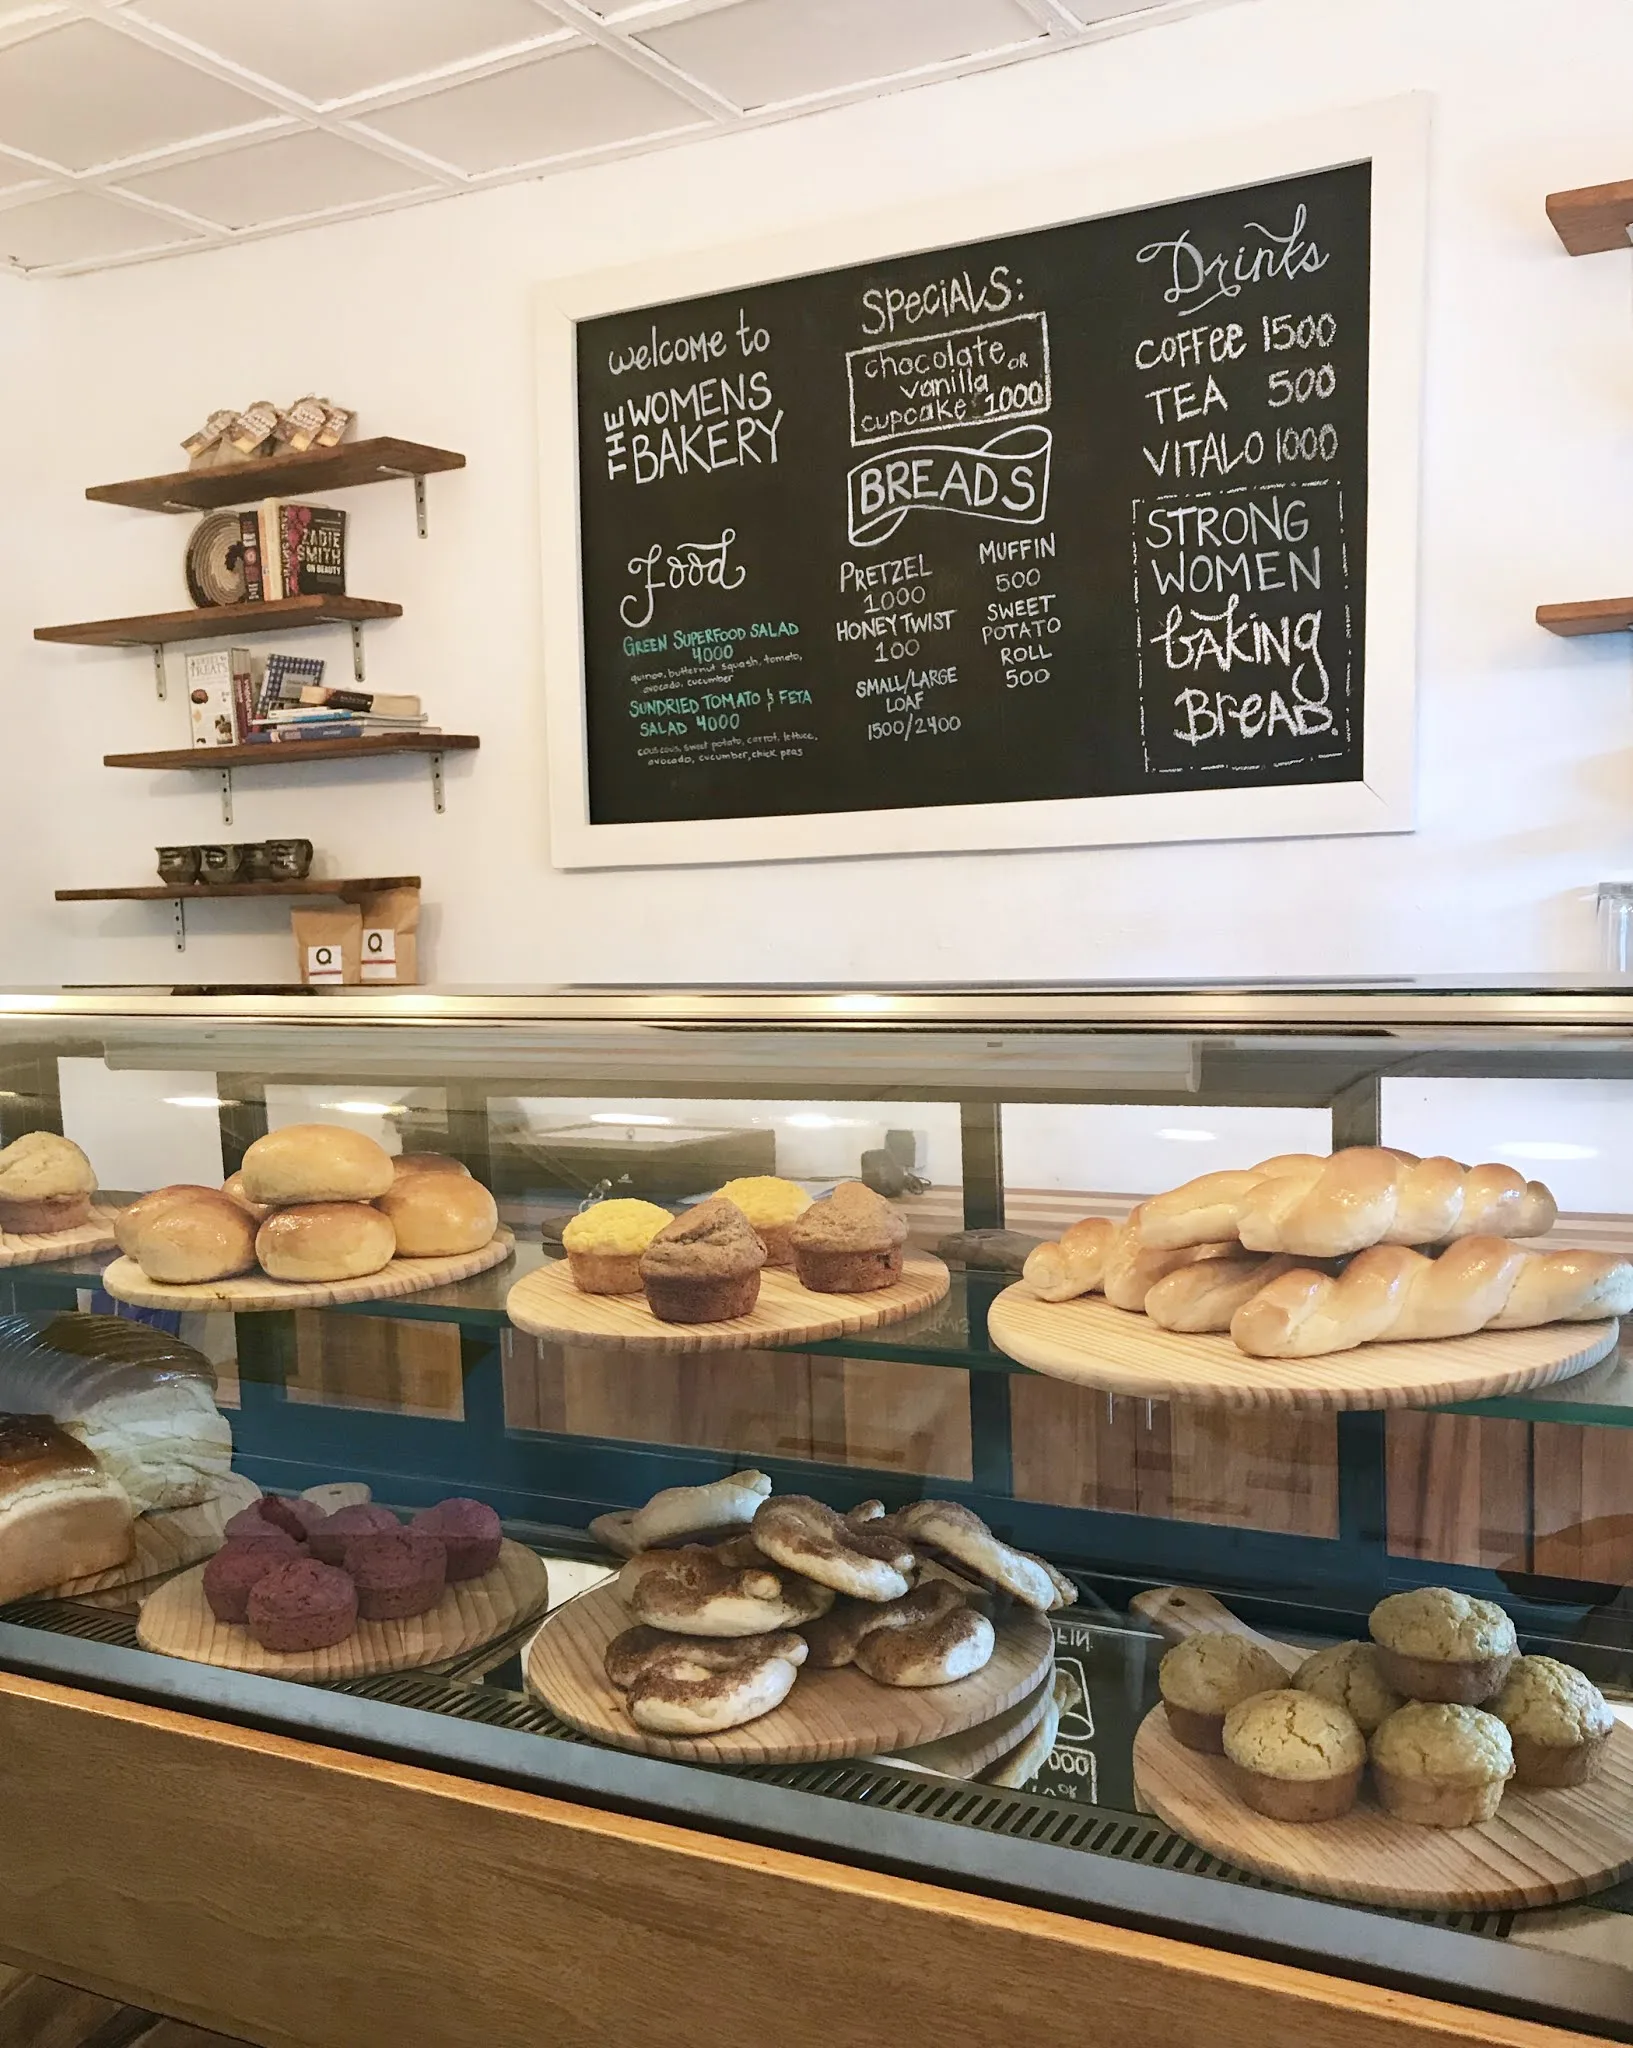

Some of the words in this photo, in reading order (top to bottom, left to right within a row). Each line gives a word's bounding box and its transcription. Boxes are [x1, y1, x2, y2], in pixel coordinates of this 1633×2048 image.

[1136, 203, 1330, 317] Drinks
[736, 308, 770, 356] to
[1261, 311, 1338, 353] 1500
[865, 335, 1006, 379] chocolate
[900, 369, 989, 399] vanilla
[1145, 374, 1229, 425] TEA
[1267, 361, 1337, 408] 500
[627, 371, 772, 427] WOMENS
[860, 398, 967, 434] cupcake
[983, 380, 1044, 417] 1000
[603, 405, 627, 480] THE
[632, 408, 784, 484] BAKERY
[1142, 430, 1265, 478] VITALO
[1275, 422, 1339, 465] 1000
[860, 459, 1036, 515] BREADS
[1146, 495, 1310, 549] STRONG
[301, 528, 341, 548] ZADIE
[978, 532, 1056, 565] MUFFIN
[296, 544, 341, 565] SMITH
[306, 563, 316, 574] ON
[316, 565, 341, 576] BEAUTY
[619, 528, 746, 628] Food
[840, 553, 933, 593] PRETZEL
[995, 568, 1042, 593] 500
[1151, 545, 1321, 596] WOMEN
[863, 586, 927, 614] 1000
[987, 594, 1056, 622] SWEET
[623, 634, 667, 657] GREEN
[750, 621, 799, 638] SALAD
[836, 613, 898, 642] HONEY
[899, 609, 958, 634] TWIST
[981, 617, 1062, 645] POTATO
[692, 645, 734, 664] 4000
[874, 639, 921, 663] 100
[1000, 644, 1053, 667] ROLL
[687, 674, 734, 687] cucumber
[1006, 668, 1051, 689] 500
[629, 696, 700, 718] SUNDRIED
[701, 691, 761, 710] TOMATO
[779, 689, 813, 705] FETA
[885, 691, 925, 714] LOAF
[640, 721, 688, 737] SALAD
[696, 713, 740, 732] 4000
[867, 713, 962, 742] 1500/2400
[780, 748, 804, 760] peas
[316, 948, 331, 965] Q
[368, 933, 382, 952] Q
